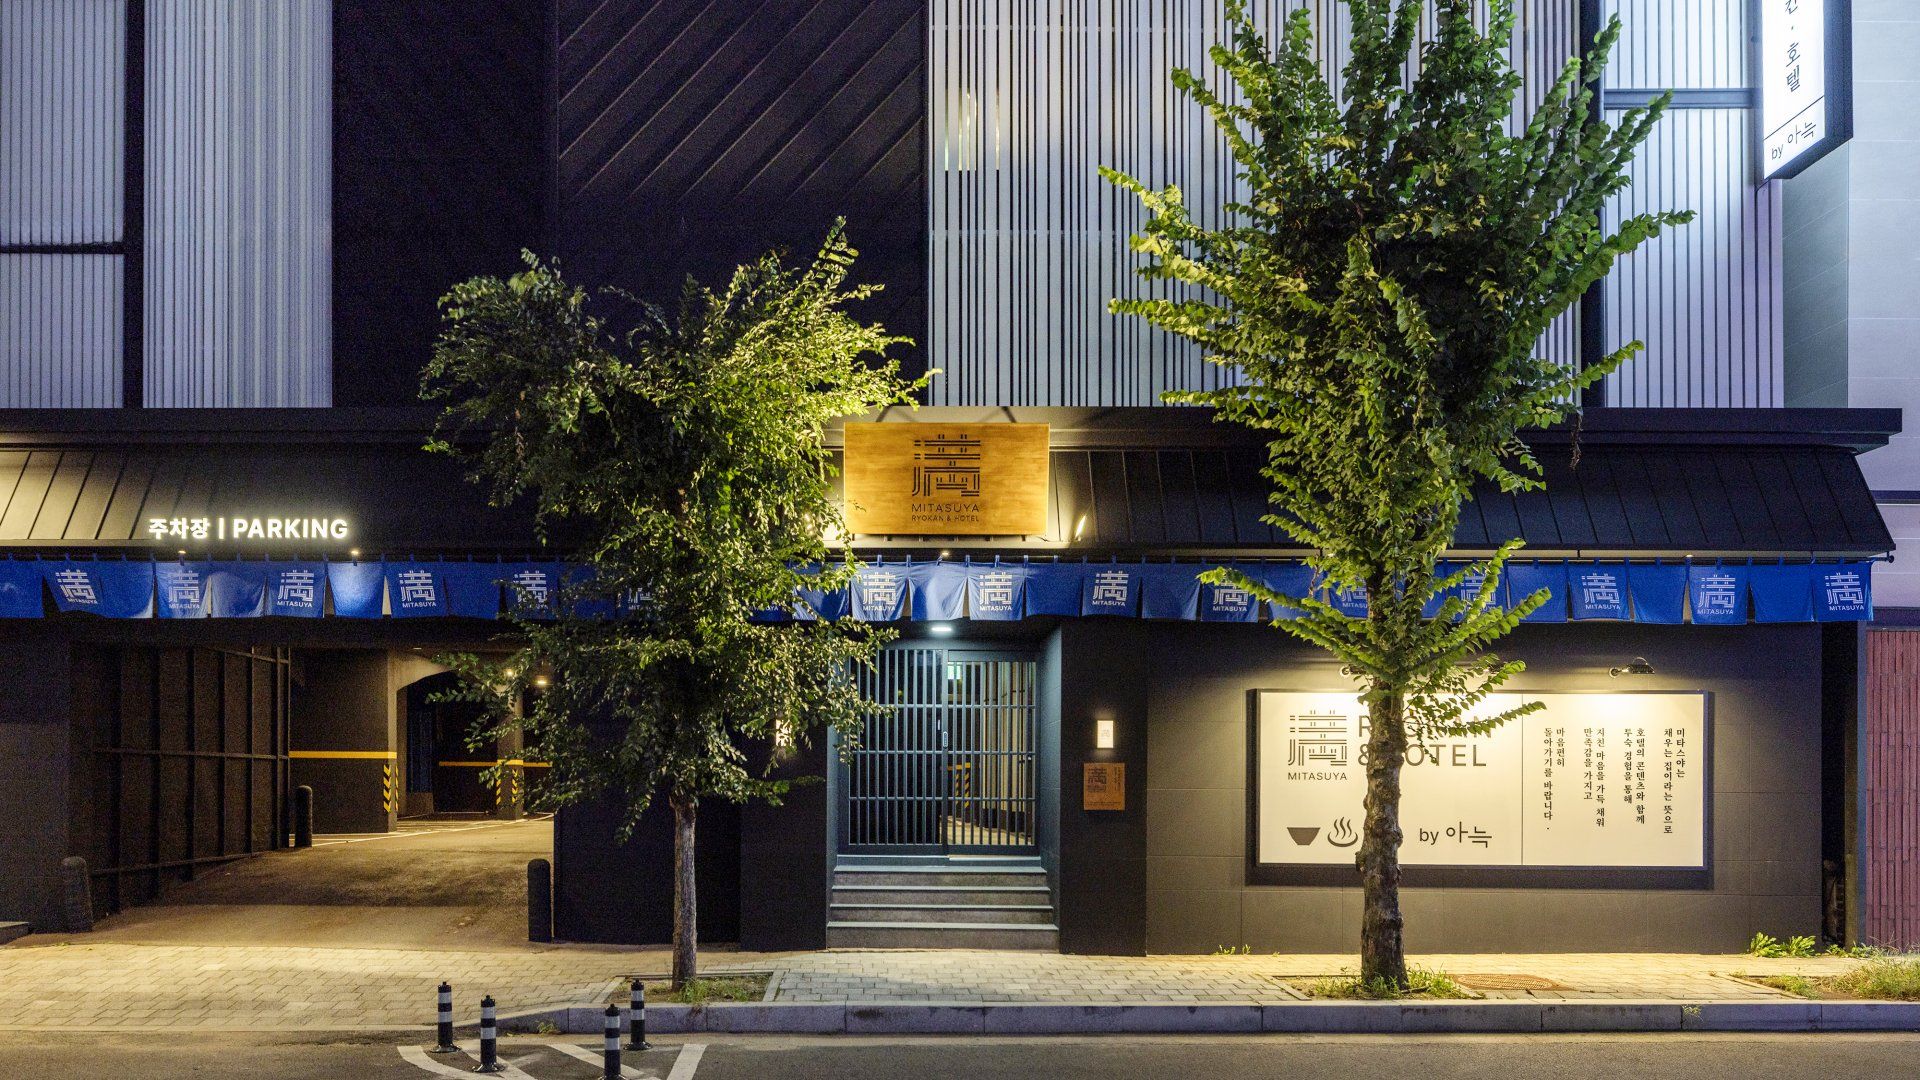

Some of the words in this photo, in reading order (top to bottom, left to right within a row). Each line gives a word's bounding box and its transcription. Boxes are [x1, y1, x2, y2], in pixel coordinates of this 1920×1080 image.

[1771, 145, 1784, 161] by
[1787, 122, 1817, 145] 아늑
[911, 503, 980, 513] MITASUYA
[149, 517, 211, 540] 주차장
[233, 518, 348, 539] PARKING
[1544, 728, 1553, 777] 돌아가기를
[1583, 728, 1593, 768] 만족감을
[1596, 728, 1605, 748] 지친
[1636, 728, 1645, 757] 호텔의
[1664, 728, 1673, 758] 채우는
[1404, 744, 1487, 767] OTEL
[1596, 751, 1605, 780] 마음을
[1624, 751, 1633, 781] 경험을
[1676, 728, 1685, 778] 미타스야는
[1287, 772, 1347, 781] MITASUYA
[1583, 770, 1593, 800] 가지고
[1664, 761, 1673, 801] 집이라는
[1596, 784, 1605, 804] 가득
[1624, 784, 1633, 804] 통해
[1596, 807, 1605, 827] 채워
[1636, 804, 1645, 824] 함께
[1664, 805, 1673, 834] 뜻으로
[1419, 828, 1439, 845] by
[1446, 821, 1493, 848] 아늑
